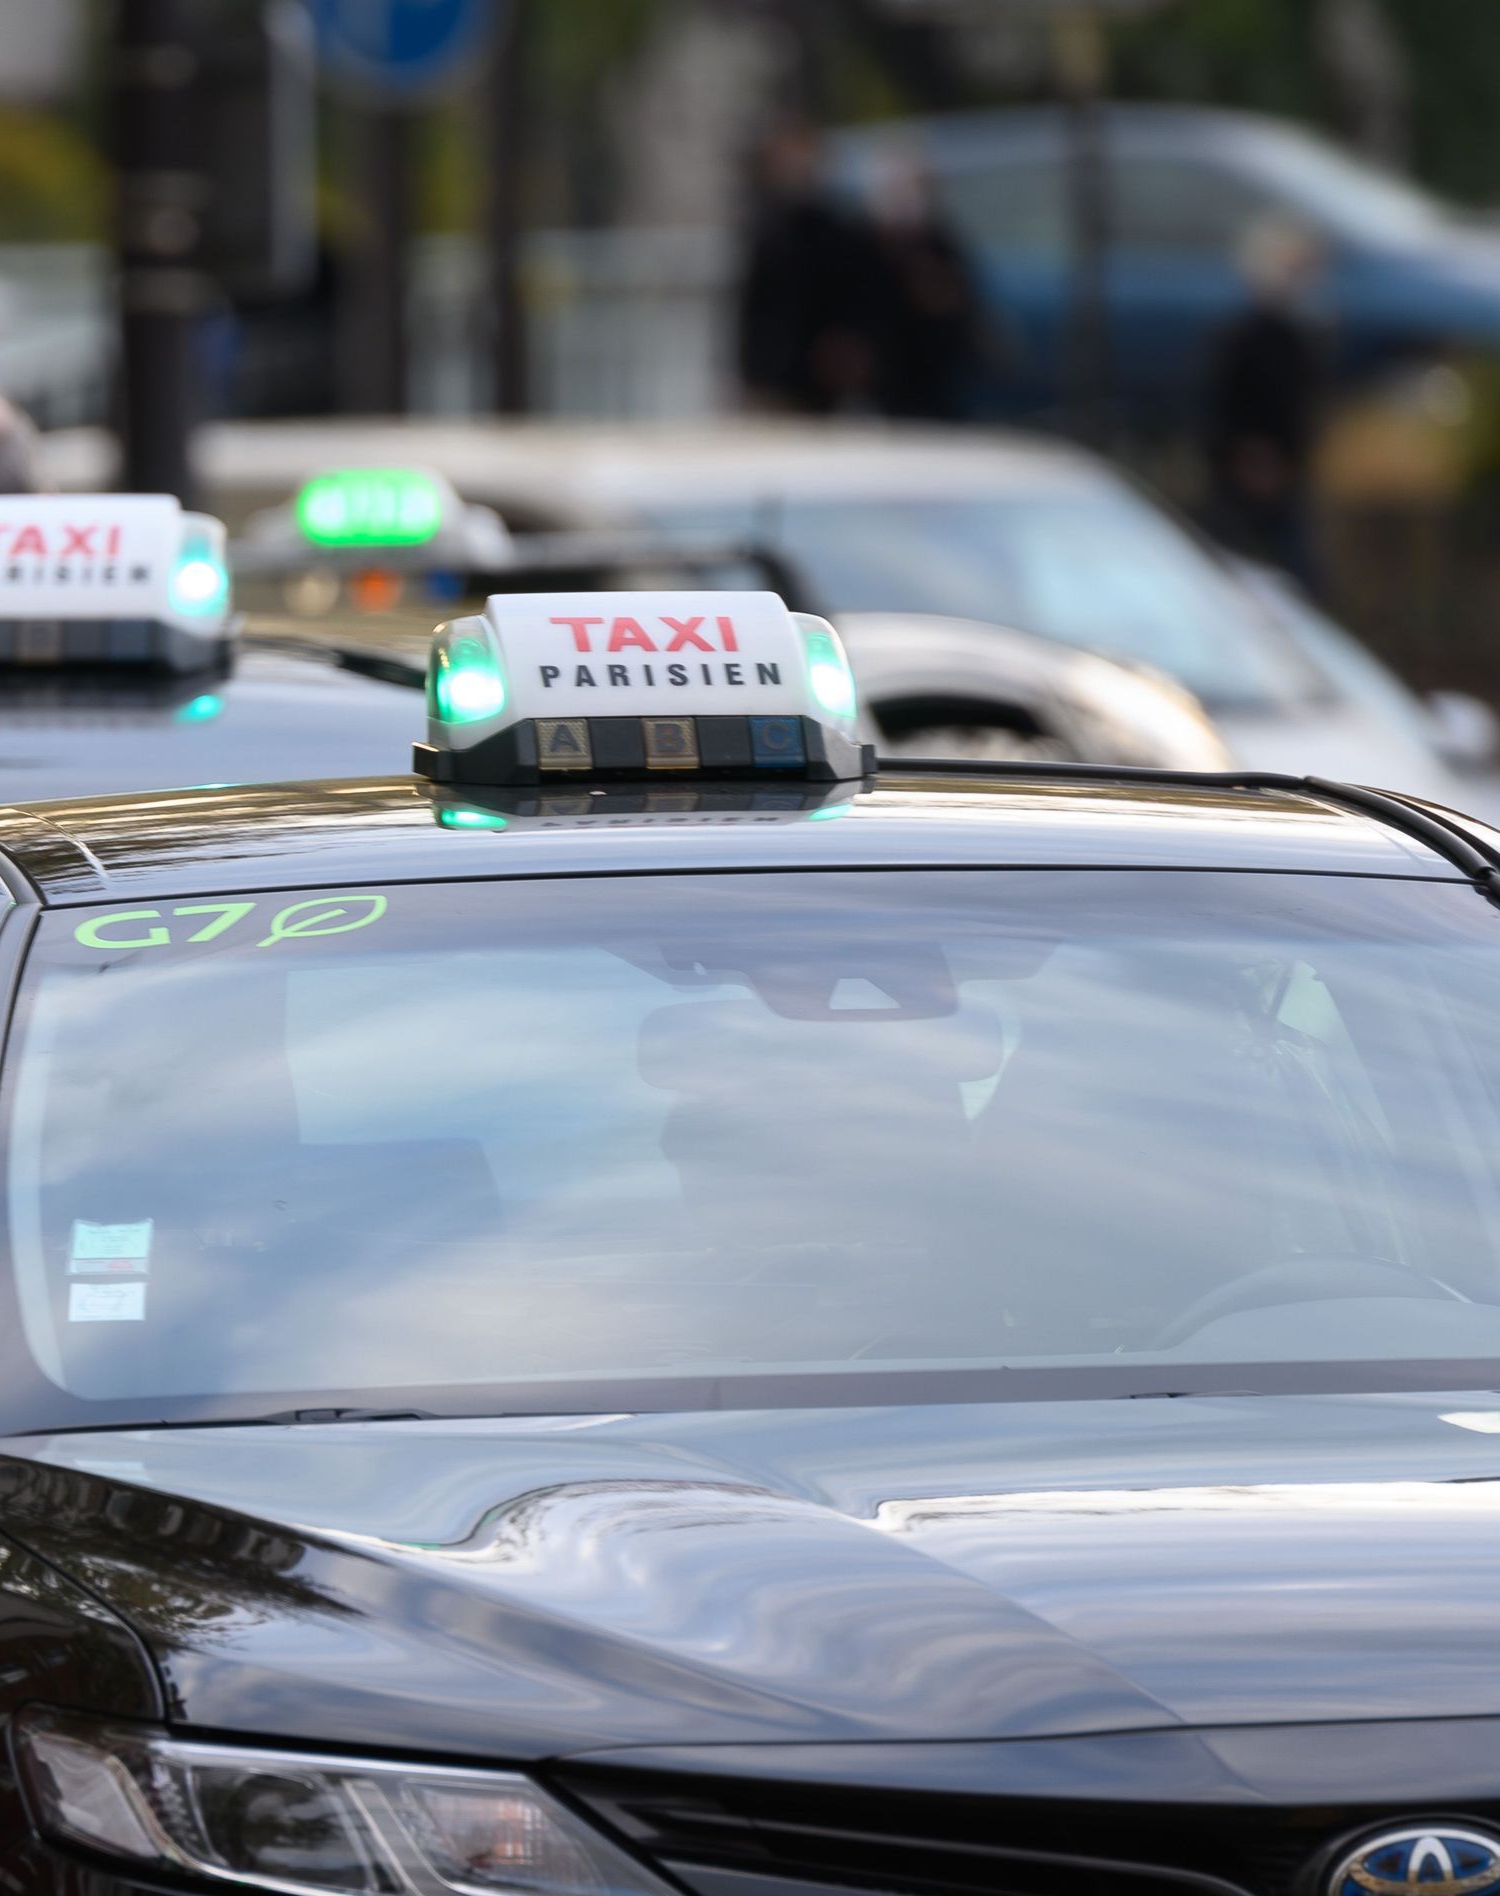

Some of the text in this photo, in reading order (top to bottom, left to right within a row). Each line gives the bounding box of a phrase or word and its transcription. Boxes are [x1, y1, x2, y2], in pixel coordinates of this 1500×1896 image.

[548, 615, 740, 653] TAXI
[538, 662, 783, 689] PARISIEN
[549, 719, 794, 753] A B C
[72, 902, 258, 950] G7
